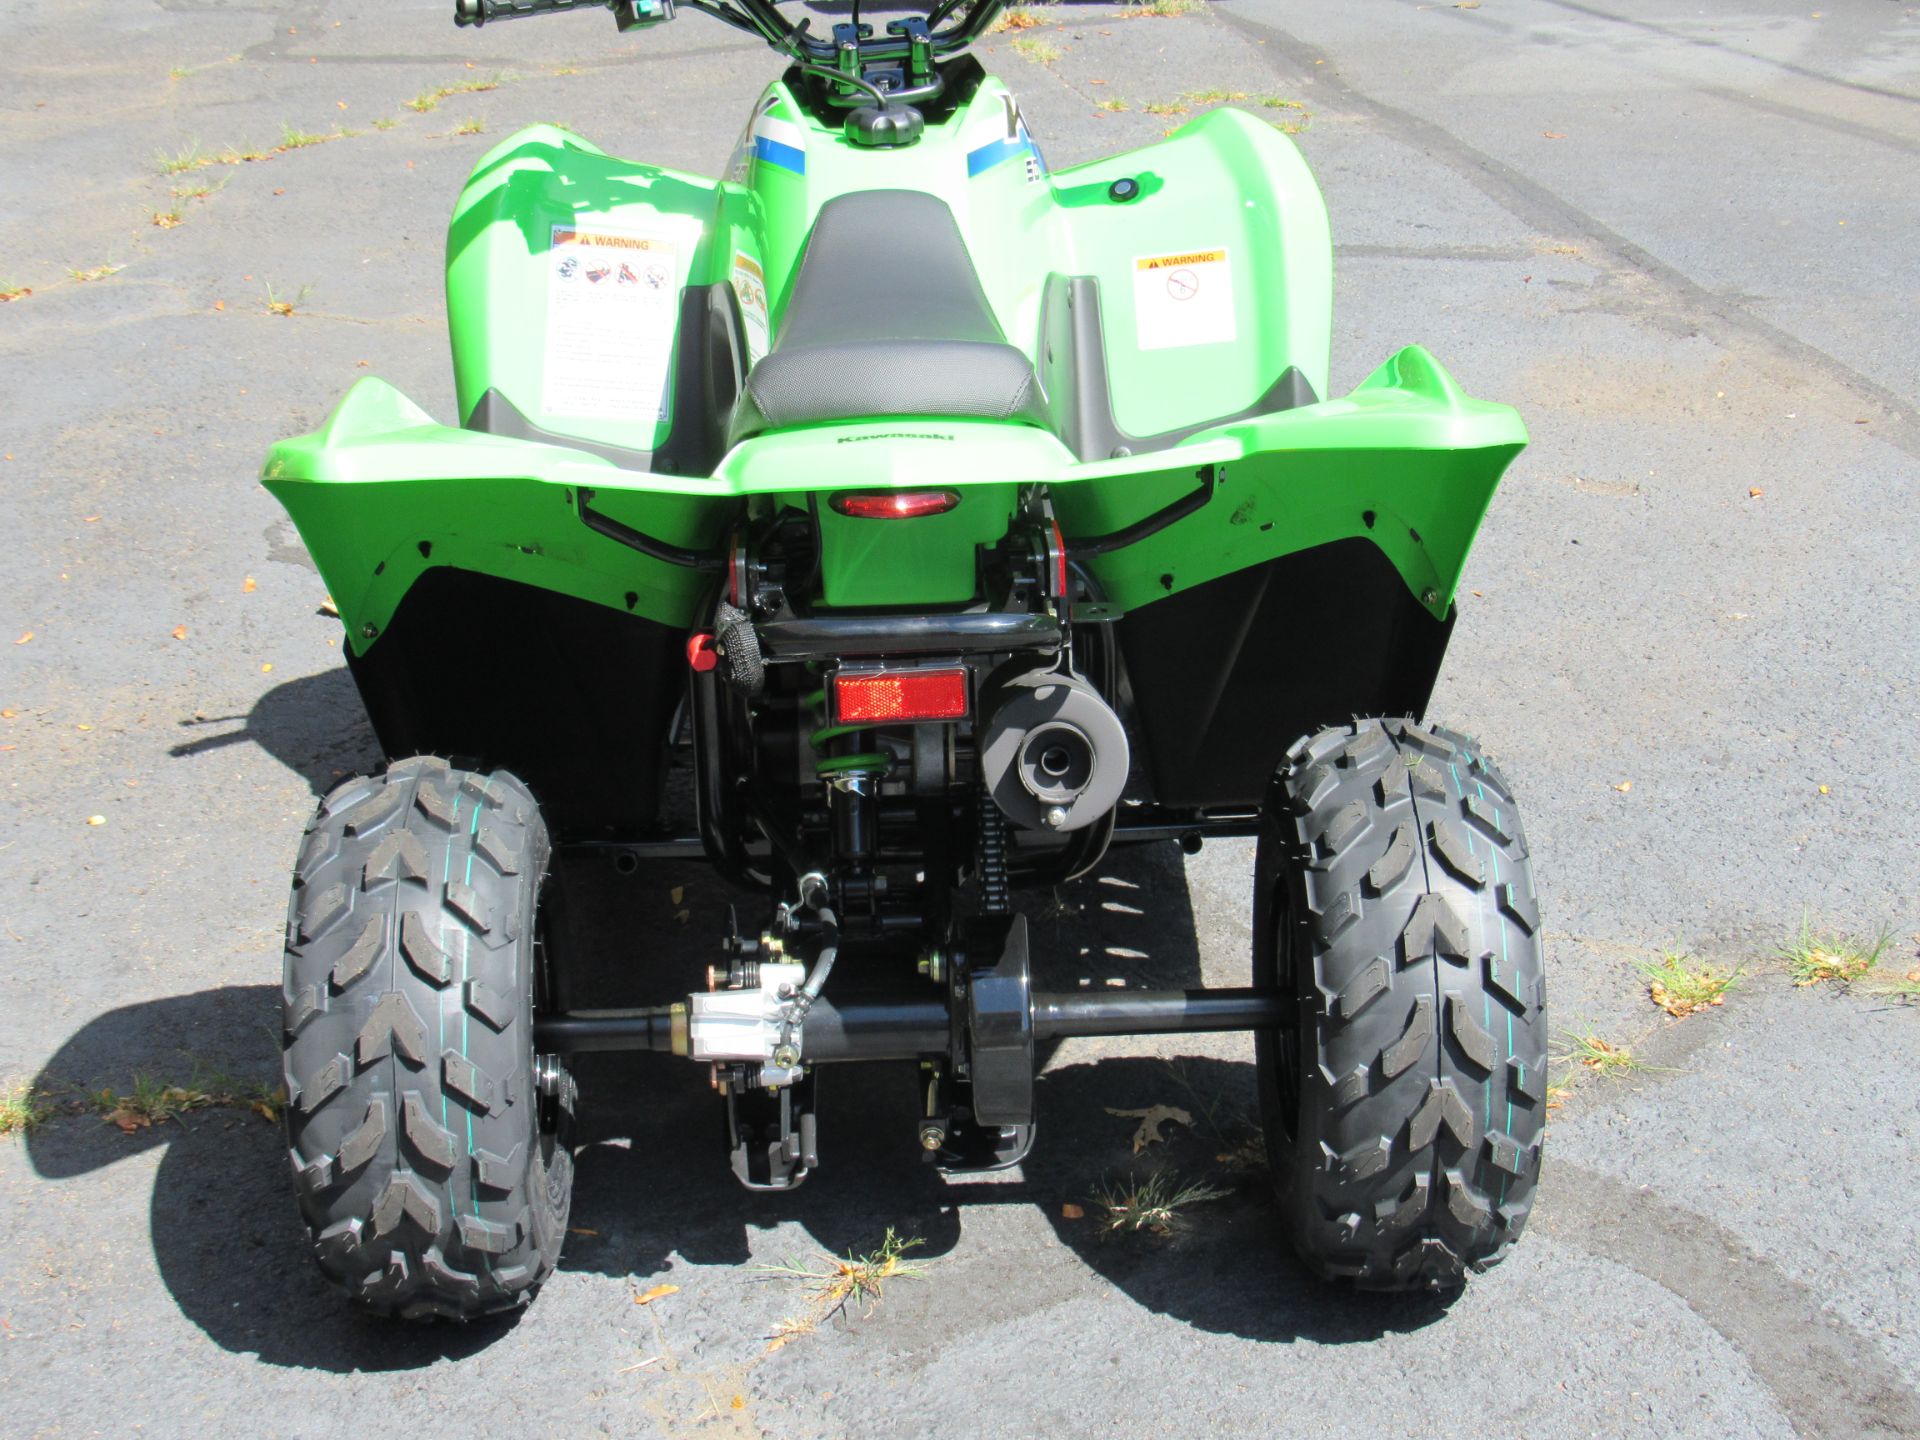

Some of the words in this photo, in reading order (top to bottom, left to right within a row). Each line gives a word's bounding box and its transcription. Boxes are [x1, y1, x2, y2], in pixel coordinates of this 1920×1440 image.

[595, 236, 649, 250] WARNING
[1162, 253, 1214, 267] WARNING
[837, 433, 954, 444] Kawasaki
